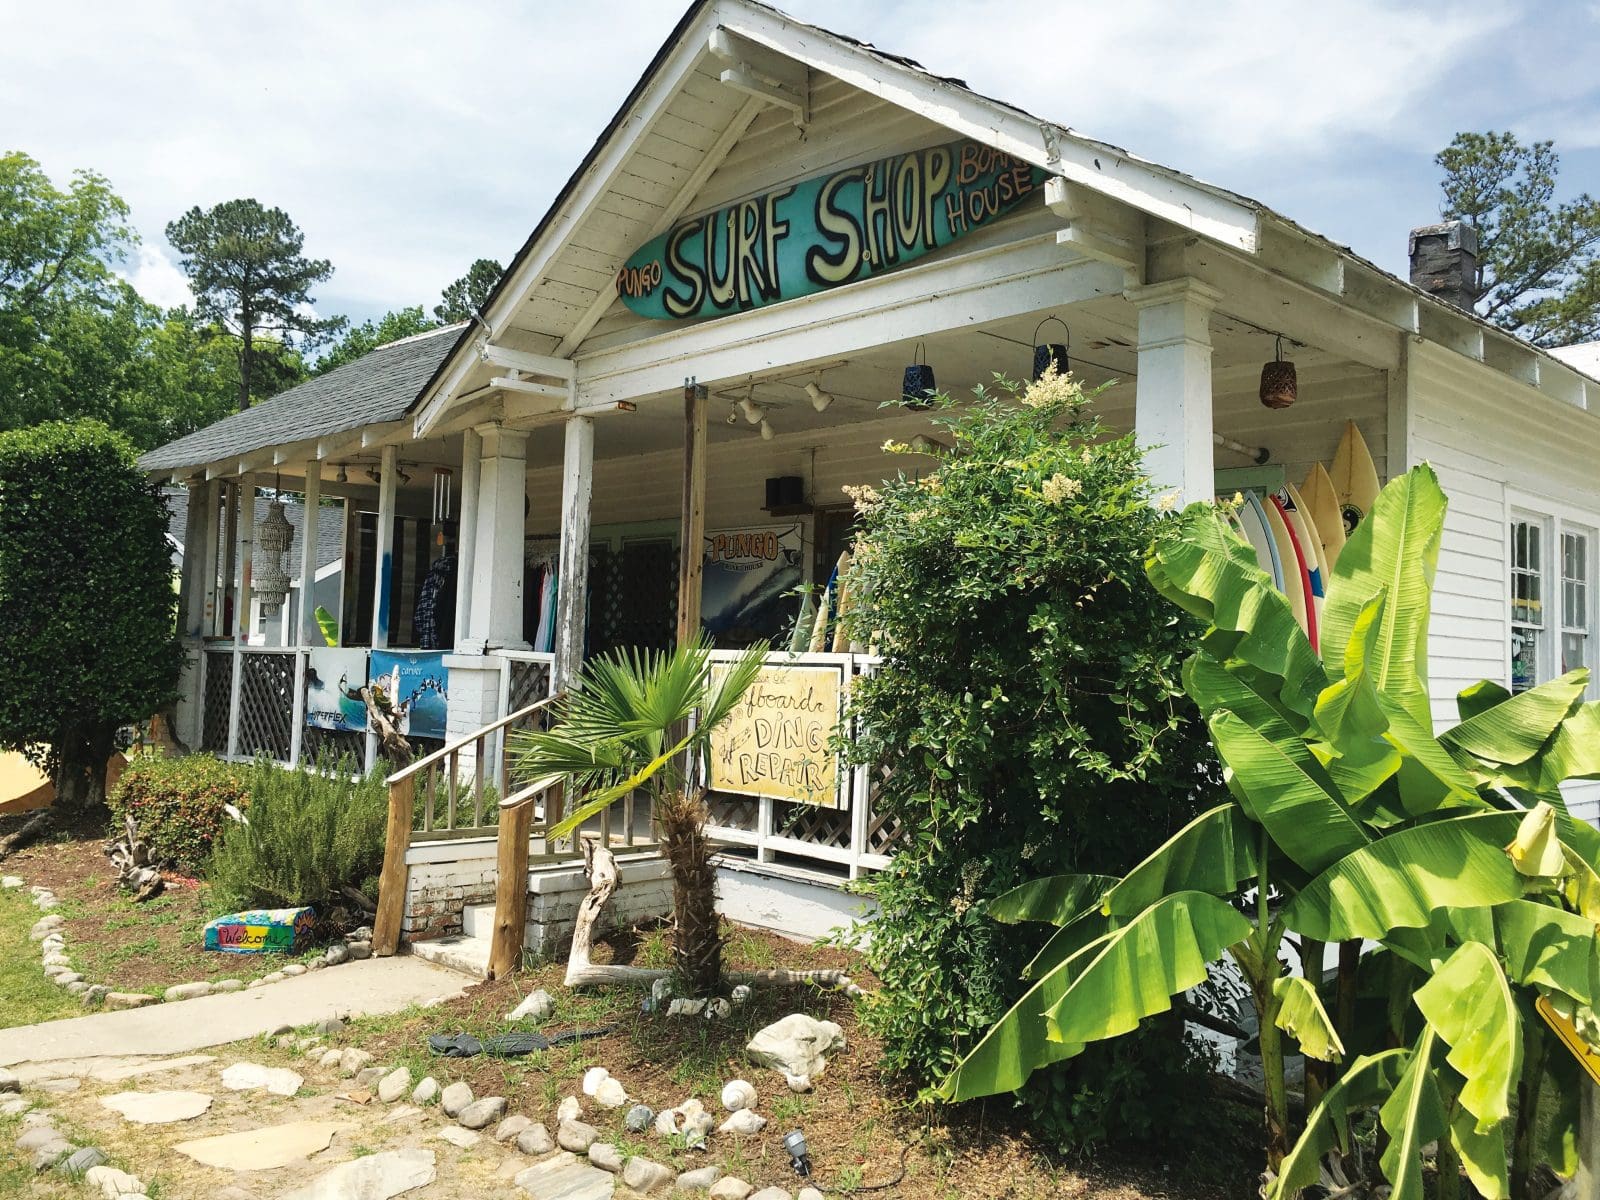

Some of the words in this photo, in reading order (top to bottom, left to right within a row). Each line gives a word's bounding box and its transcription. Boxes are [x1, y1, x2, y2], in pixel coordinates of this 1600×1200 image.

[945, 166, 1032, 233] HOUSE
[616, 259, 662, 298] PUNGO
[664, 186, 796, 318] SURF
[806, 147, 953, 285] SHOP
[711, 532, 779, 564] PUNGO
[223, 928, 290, 945] Welcome
